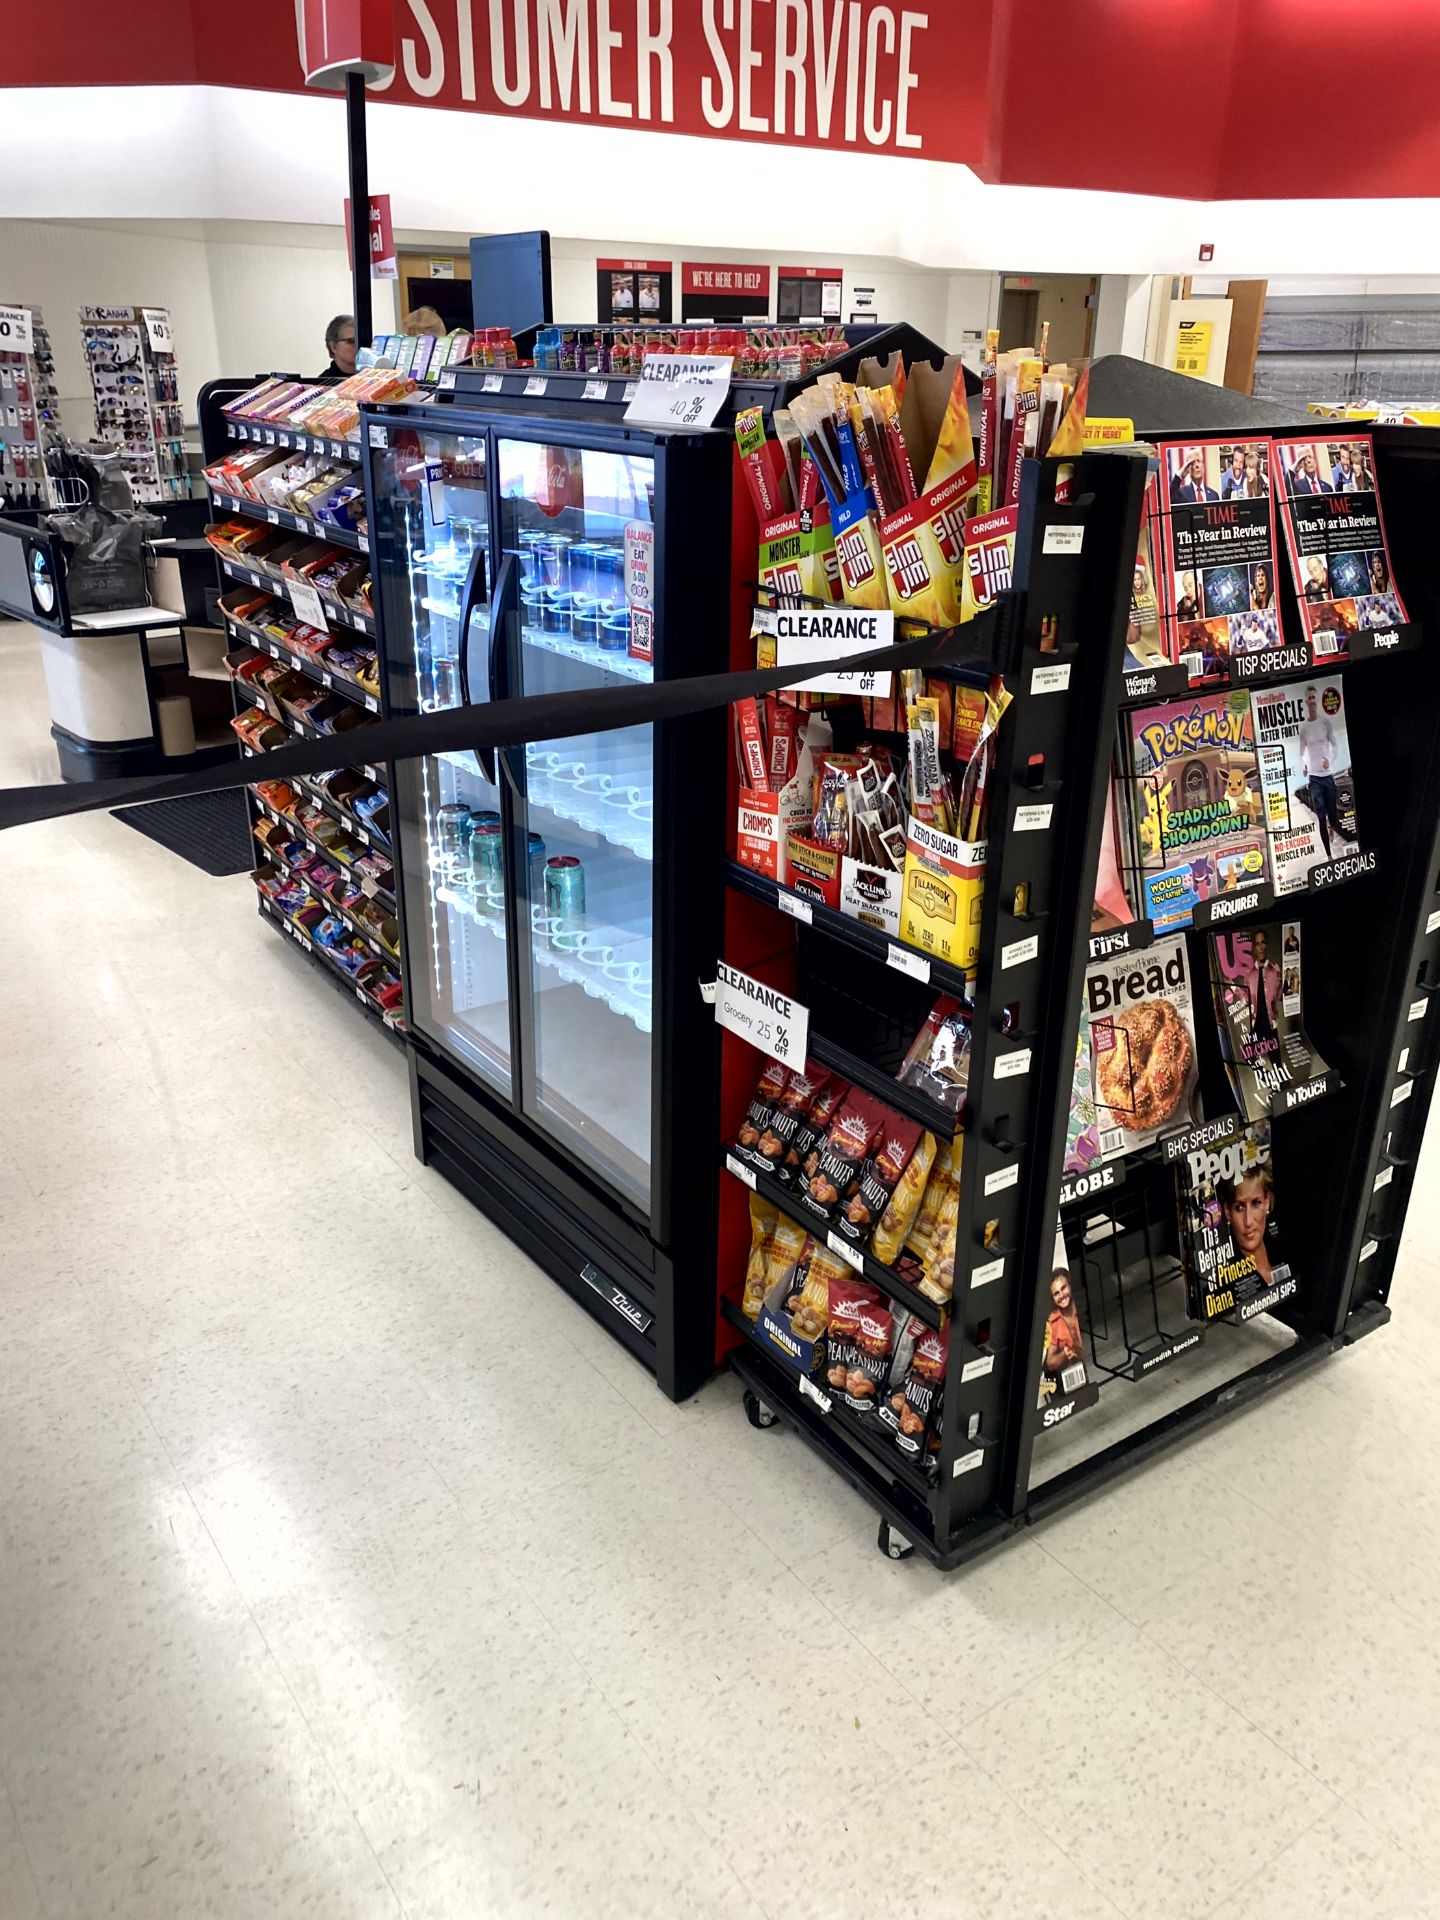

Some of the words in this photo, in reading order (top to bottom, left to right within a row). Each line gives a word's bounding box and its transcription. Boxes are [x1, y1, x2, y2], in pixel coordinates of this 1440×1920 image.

[700, 0, 930, 149] SERVICE
[692, 270, 714, 288] WE'RE
[715, 271, 733, 288] HERE
[734, 273, 744, 289] TO
[744, 273, 761, 289] HELP
[152, 324, 164, 339] 40
[641, 362, 716, 385] CLEARANCE
[669, 400, 687, 416] 40
[689, 396, 705, 414] %
[682, 414, 699, 423] OFF
[979, 408, 988, 467] ORIGINAL
[1102, 430, 1122, 439] HERE!
[755, 465, 772, 510] ORIGINAL
[842, 463, 852, 491] MILD
[930, 476, 968, 508] ORIGINAL
[838, 509, 851, 526] MILD
[882, 512, 914, 536] ORIGINAL
[972, 515, 1010, 535] ORIGINAL
[1203, 504, 1239, 526] TIME
[1297, 519, 1318, 533] The
[1338, 516, 1349, 529] in
[1347, 514, 1378, 528] Review
[626, 529, 652, 544] BALANCE
[764, 518, 798, 538] ORIGINAL
[1176, 530, 1198, 545] The
[1197, 529, 1221, 543] Year
[1220, 526, 1232, 540] in
[1232, 523, 1267, 539] Review
[633, 549, 645, 560] EAT
[768, 535, 800, 564] MONSTER
[630, 559, 648, 573] DRINK
[637, 572, 646, 584] DO
[777, 615, 878, 640] CLEARANCE
[1373, 630, 1400, 649] People
[1235, 655, 1259, 677] TISP
[1260, 646, 1308, 673] SPECIALS
[859, 678, 875, 691] OFF
[1126, 674, 1157, 690] Woman's
[1127, 683, 1148, 697] World
[1257, 698, 1305, 730] MUSCLE
[1260, 727, 1280, 744] AFTER
[1280, 724, 1300, 739] FORTY
[748, 742, 763, 777] CHOMPS
[773, 737, 787, 772] CHOMPS
[1265, 771, 1274, 782] FAT
[1268, 791, 1280, 799] Fast
[742, 811, 773, 836] CHOMPS
[1167, 802, 1231, 830] STADIUM
[913, 823, 930, 846] ZERO
[930, 834, 959, 859] SUGAR
[1162, 815, 1250, 849] SHOWDOWN!
[1273, 822, 1315, 843] NO-EQUIPMENT
[788, 839, 798, 849] BEEF
[798, 845, 812, 856] STICK
[815, 852, 834, 866] CHEESE
[1274, 835, 1311, 853] NO-EXCUSES
[1275, 846, 1300, 864] MUSCLE
[1300, 844, 1315, 857] PLAN
[1314, 865, 1333, 887] SPC
[1334, 852, 1376, 881] SPECIALS
[795, 881, 808, 897] JACK
[807, 887, 826, 904] LINK'S
[853, 878, 870, 892] JACK
[869, 882, 891, 899] LINK'S
[913, 876, 950, 906] TILLAMOOK
[1150, 875, 1182, 894] WOULD
[845, 895, 860, 906] MEAT
[861, 901, 880, 912] SNACK
[881, 907, 898, 919] STICK
[1151, 893, 1164, 905] YOU
[1210, 892, 1259, 921] ENQUIRER
[859, 912, 884, 926] ORIGINAL
[921, 928, 934, 944] ZERO
[1088, 930, 1130, 958] First
[1113, 963, 1134, 977] Taste
[1137, 955, 1161, 970] Home
[717, 963, 792, 1020] CLEARANCE
[1086, 946, 1186, 1014] Bread
[1158, 984, 1187, 998] RECIPES
[723, 1001, 754, 1029] Grocery
[756, 1019, 771, 1040] 25
[776, 1024, 789, 1048] %
[774, 1043, 789, 1057] OFF
[1254, 1060, 1293, 1093] Right
[1295, 1080, 1327, 1103] TOUCH
[1167, 1136, 1190, 1159] BHG
[1189, 1117, 1235, 1150] SPECIALS
[1186, 1127, 1271, 1188] People
[1202, 1227, 1220, 1251] The
[1207, 1273, 1217, 1294] of
[1216, 1254, 1258, 1288] Princess
[612, 1286, 643, 1327] True
[1205, 1290, 1235, 1319] Diana
[1241, 1285, 1280, 1321] Centennial
[1279, 1279, 1297, 1300] SIPS
[763, 1316, 802, 1358] ORIGINAL
[863, 1319, 878, 1332] NUT
[848, 1346, 889, 1380] PEANUTS
[1142, 1349, 1172, 1370] meredith
[1171, 1334, 1200, 1355] Specials
[1043, 1400, 1076, 1428] Star
